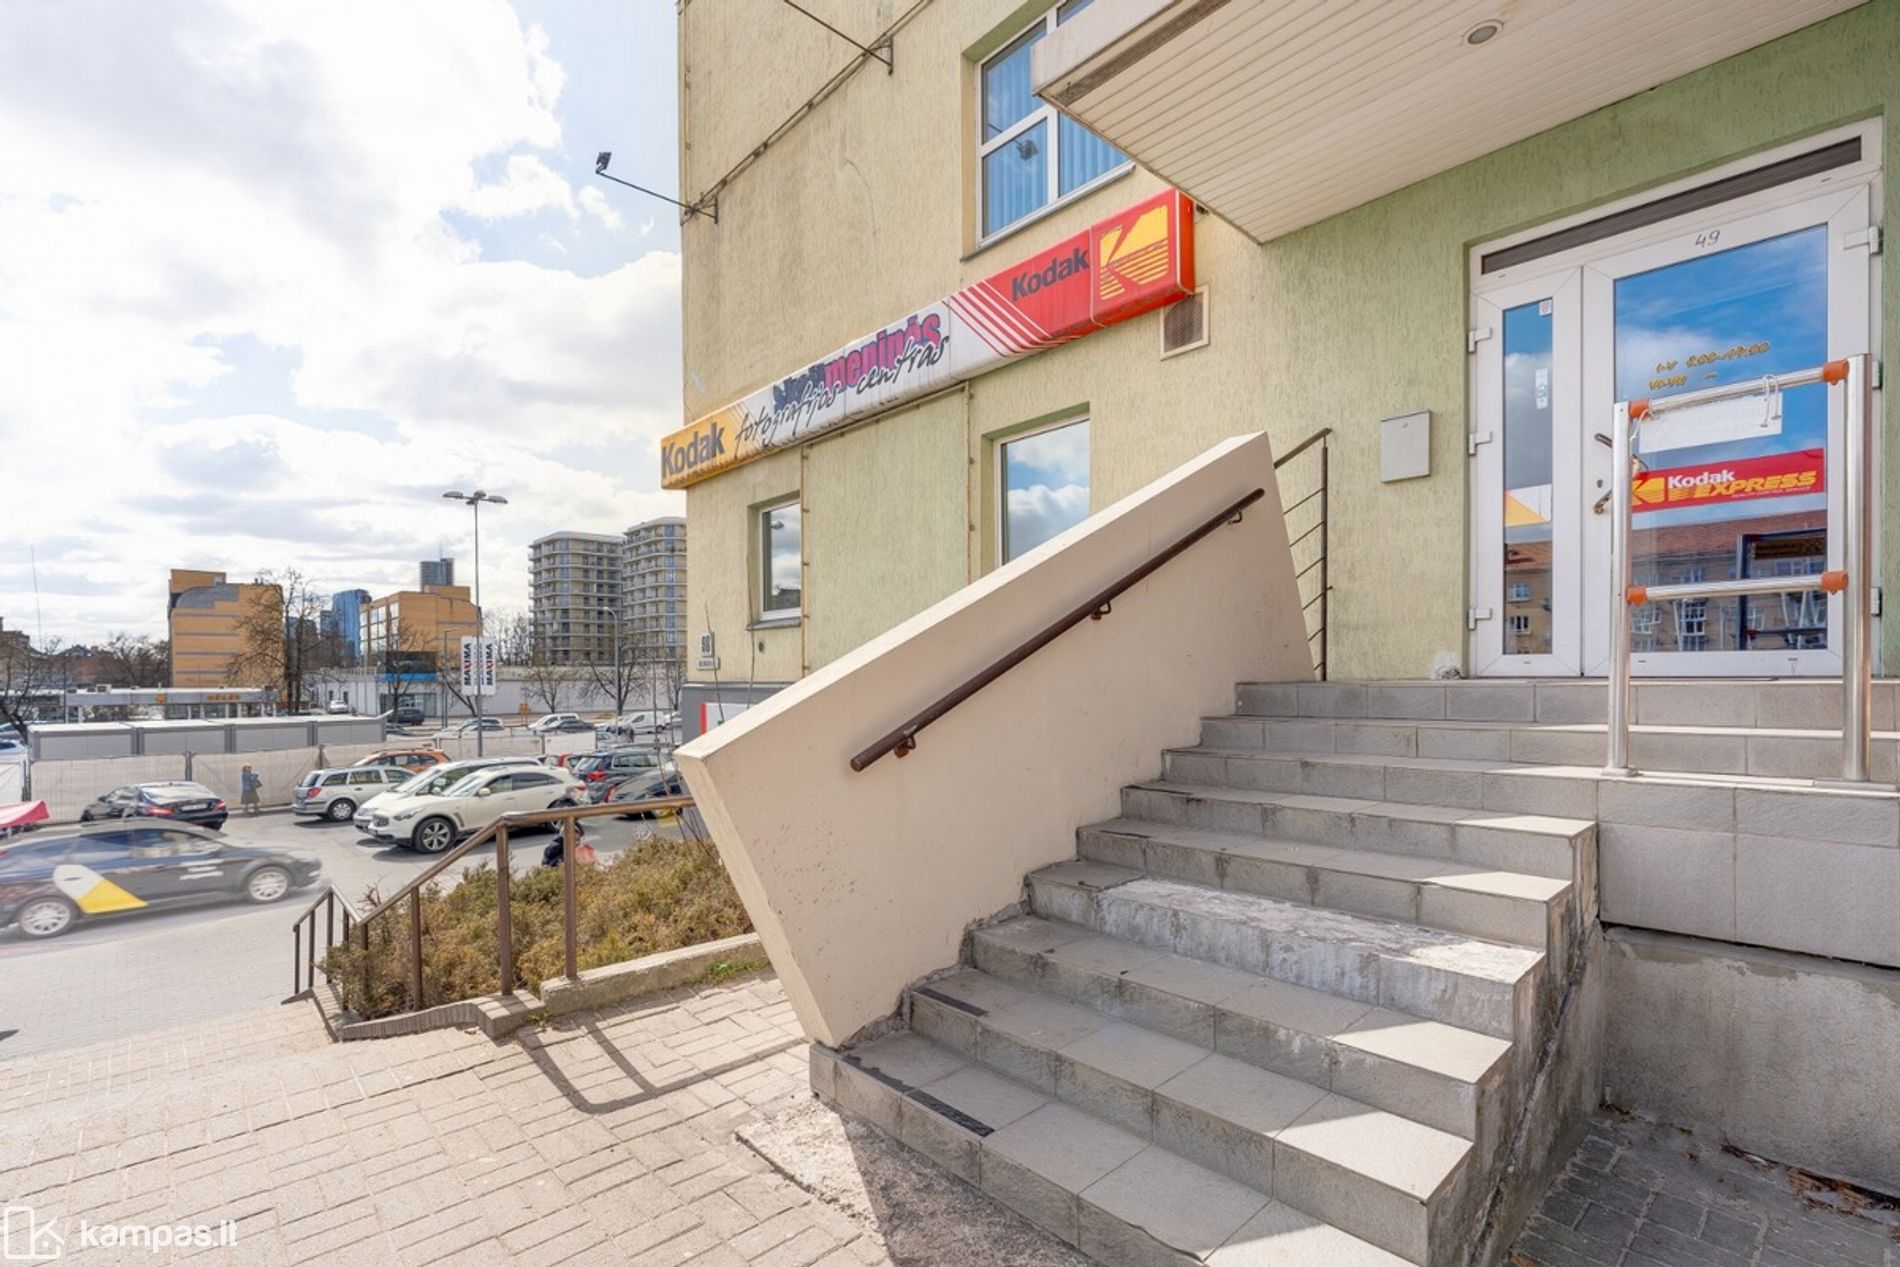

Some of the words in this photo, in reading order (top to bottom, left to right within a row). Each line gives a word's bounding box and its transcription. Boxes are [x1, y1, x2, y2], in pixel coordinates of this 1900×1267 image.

[1695, 229, 1720, 248] 49
[1012, 247, 1089, 301] Kodak
[856, 335, 950, 395] centras
[661, 422, 725, 477] Kodak
[1668, 470, 1735, 489] Kodak
[1693, 471, 1817, 498] EXPRESS
